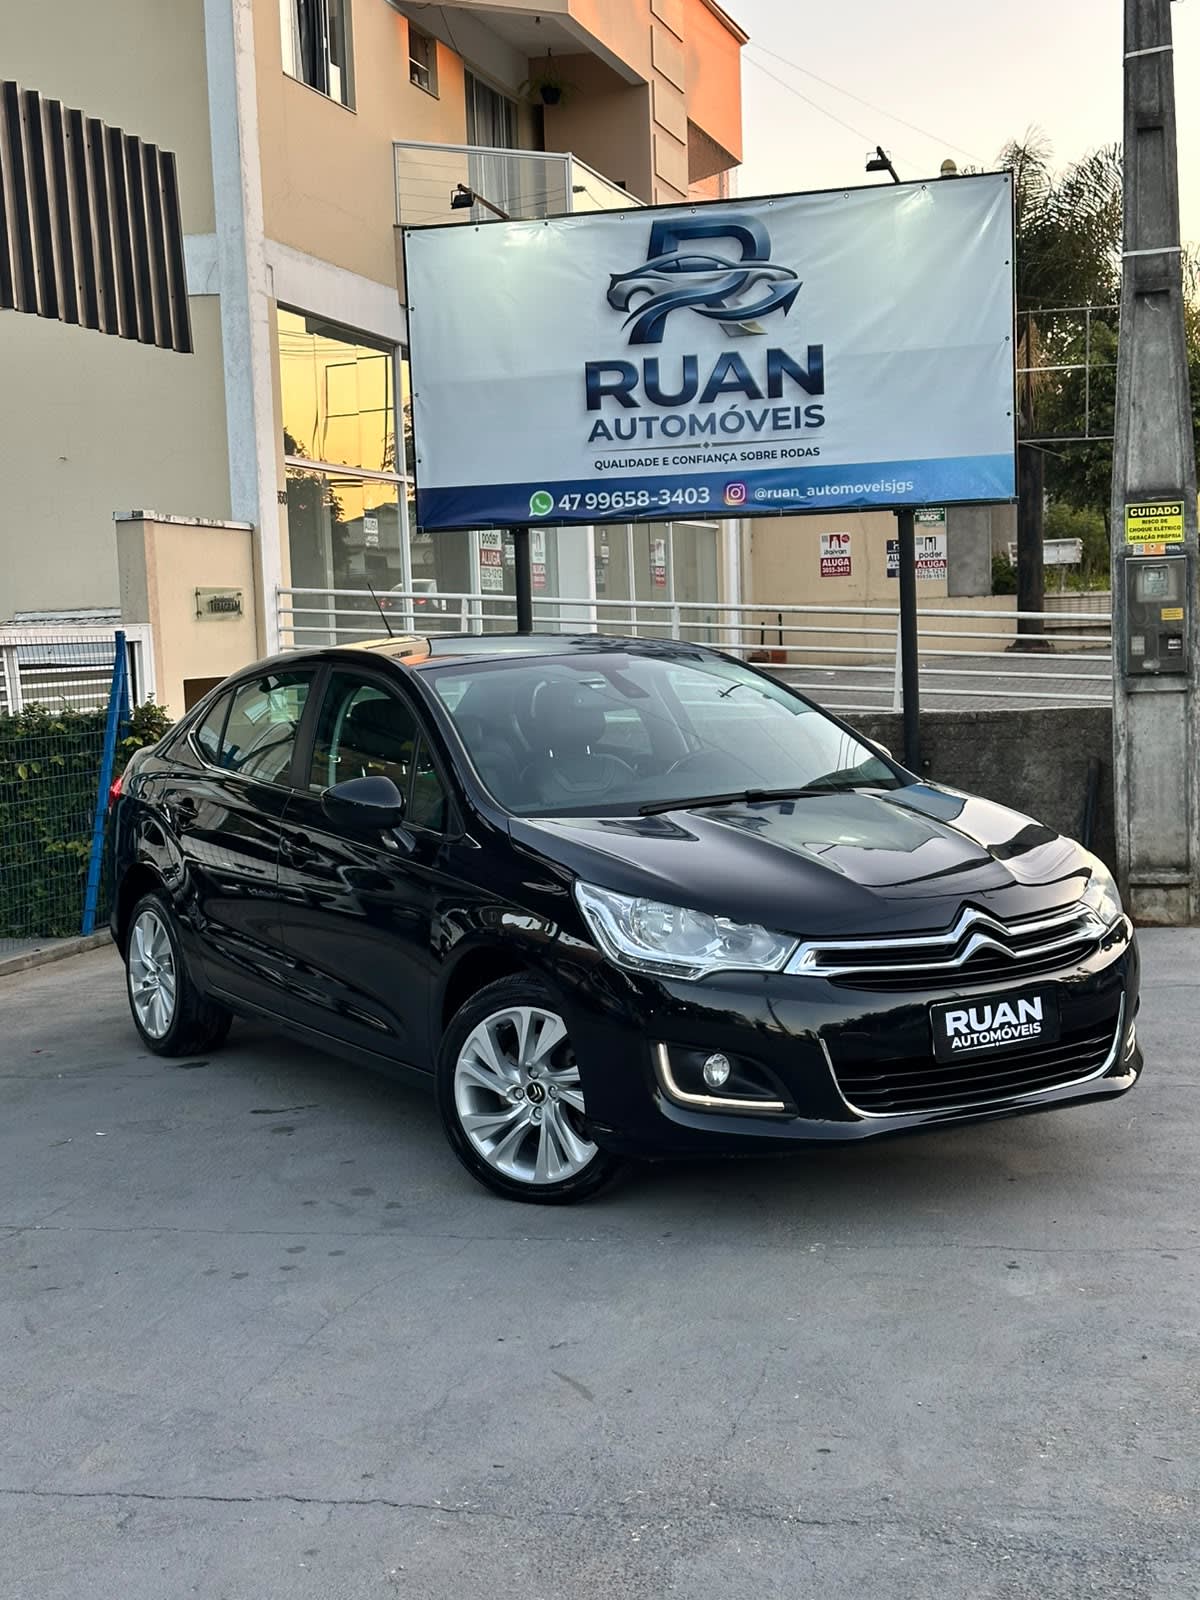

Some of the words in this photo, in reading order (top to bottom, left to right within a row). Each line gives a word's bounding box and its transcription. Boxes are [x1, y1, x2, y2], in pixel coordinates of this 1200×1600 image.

[585, 344, 825, 411] RUAN
[588, 404, 826, 443] AUTOMÓVEIS
[594, 456, 660, 470] QUALIDADE
[663, 456, 669, 466] E
[672, 450, 738, 465] CONFIANÇA
[740, 449, 778, 461] SOBRE
[780, 447, 821, 458] RODAS
[558, 494, 581, 511] 47
[585, 487, 711, 509] 99658-3403
[754, 479, 914, 500] @ruan_automoveisjgs
[1130, 506, 1180, 516] CUIDADO
[481, 550, 501, 565] ALUGA
[822, 558, 850, 567] ALUGA
[917, 560, 945, 569] ALUGA
[918, 551, 943, 560] poder
[945, 996, 1043, 1036] RUAN
[951, 1022, 1042, 1049] AUTOMÓVEIS
